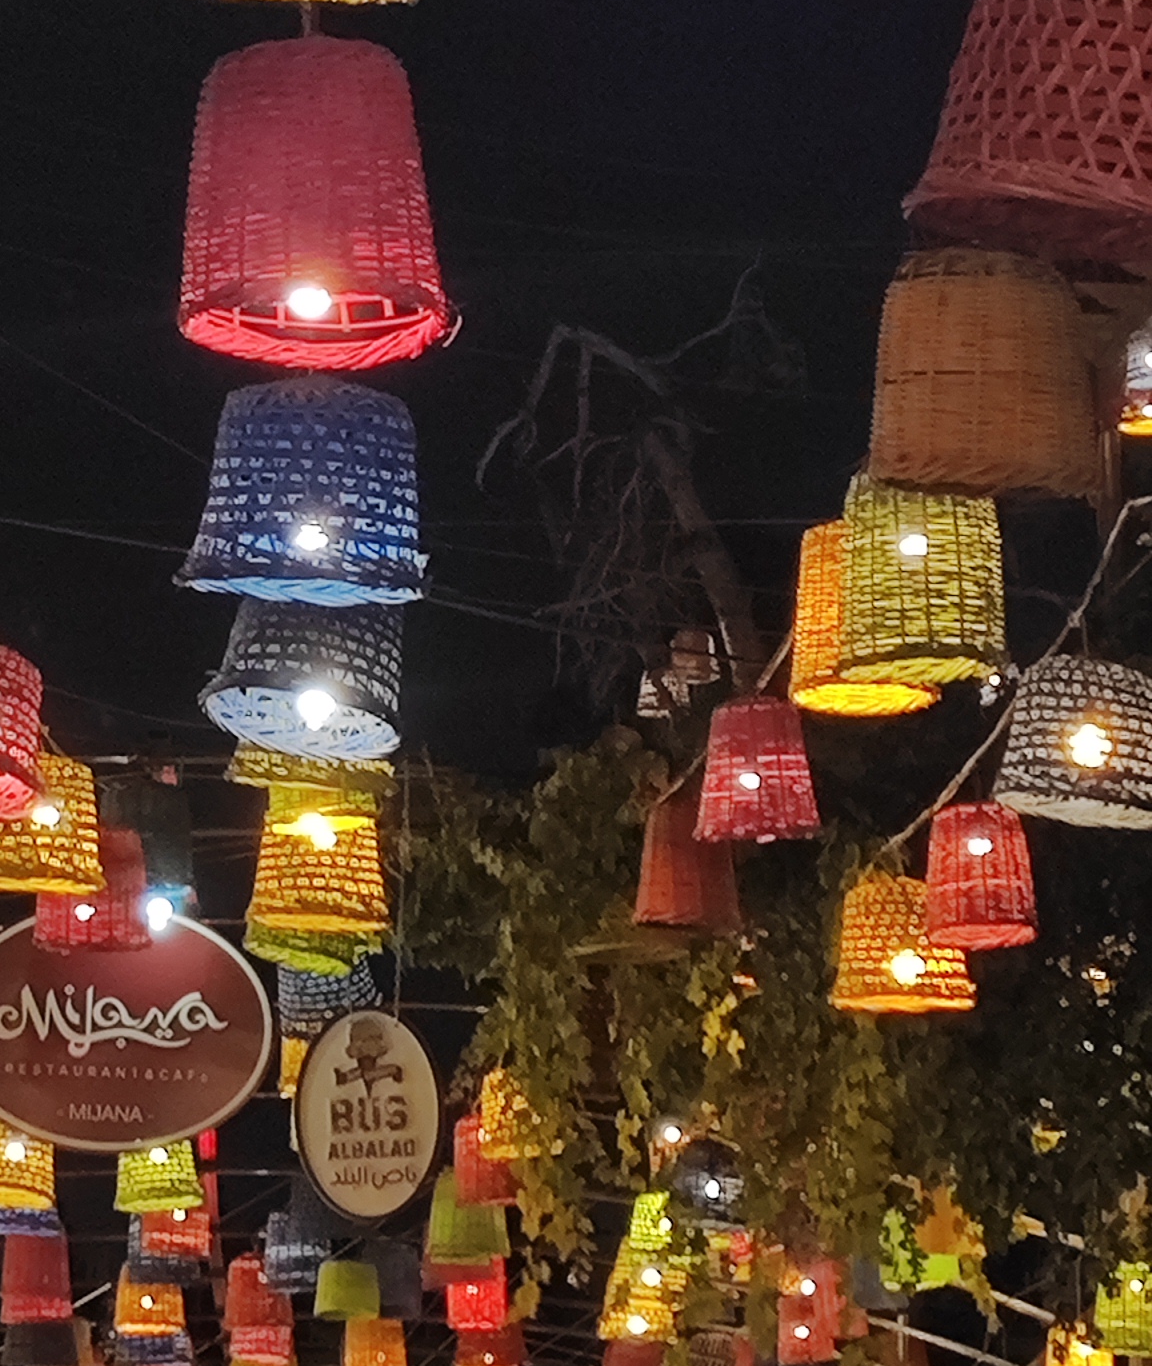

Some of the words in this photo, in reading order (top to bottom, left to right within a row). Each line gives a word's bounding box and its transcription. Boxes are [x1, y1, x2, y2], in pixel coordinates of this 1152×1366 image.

[68, 1103, 144, 1123] MIJANA
[330, 1095, 408, 1134] BUS
[328, 1138, 415, 1160] ALBALAD
